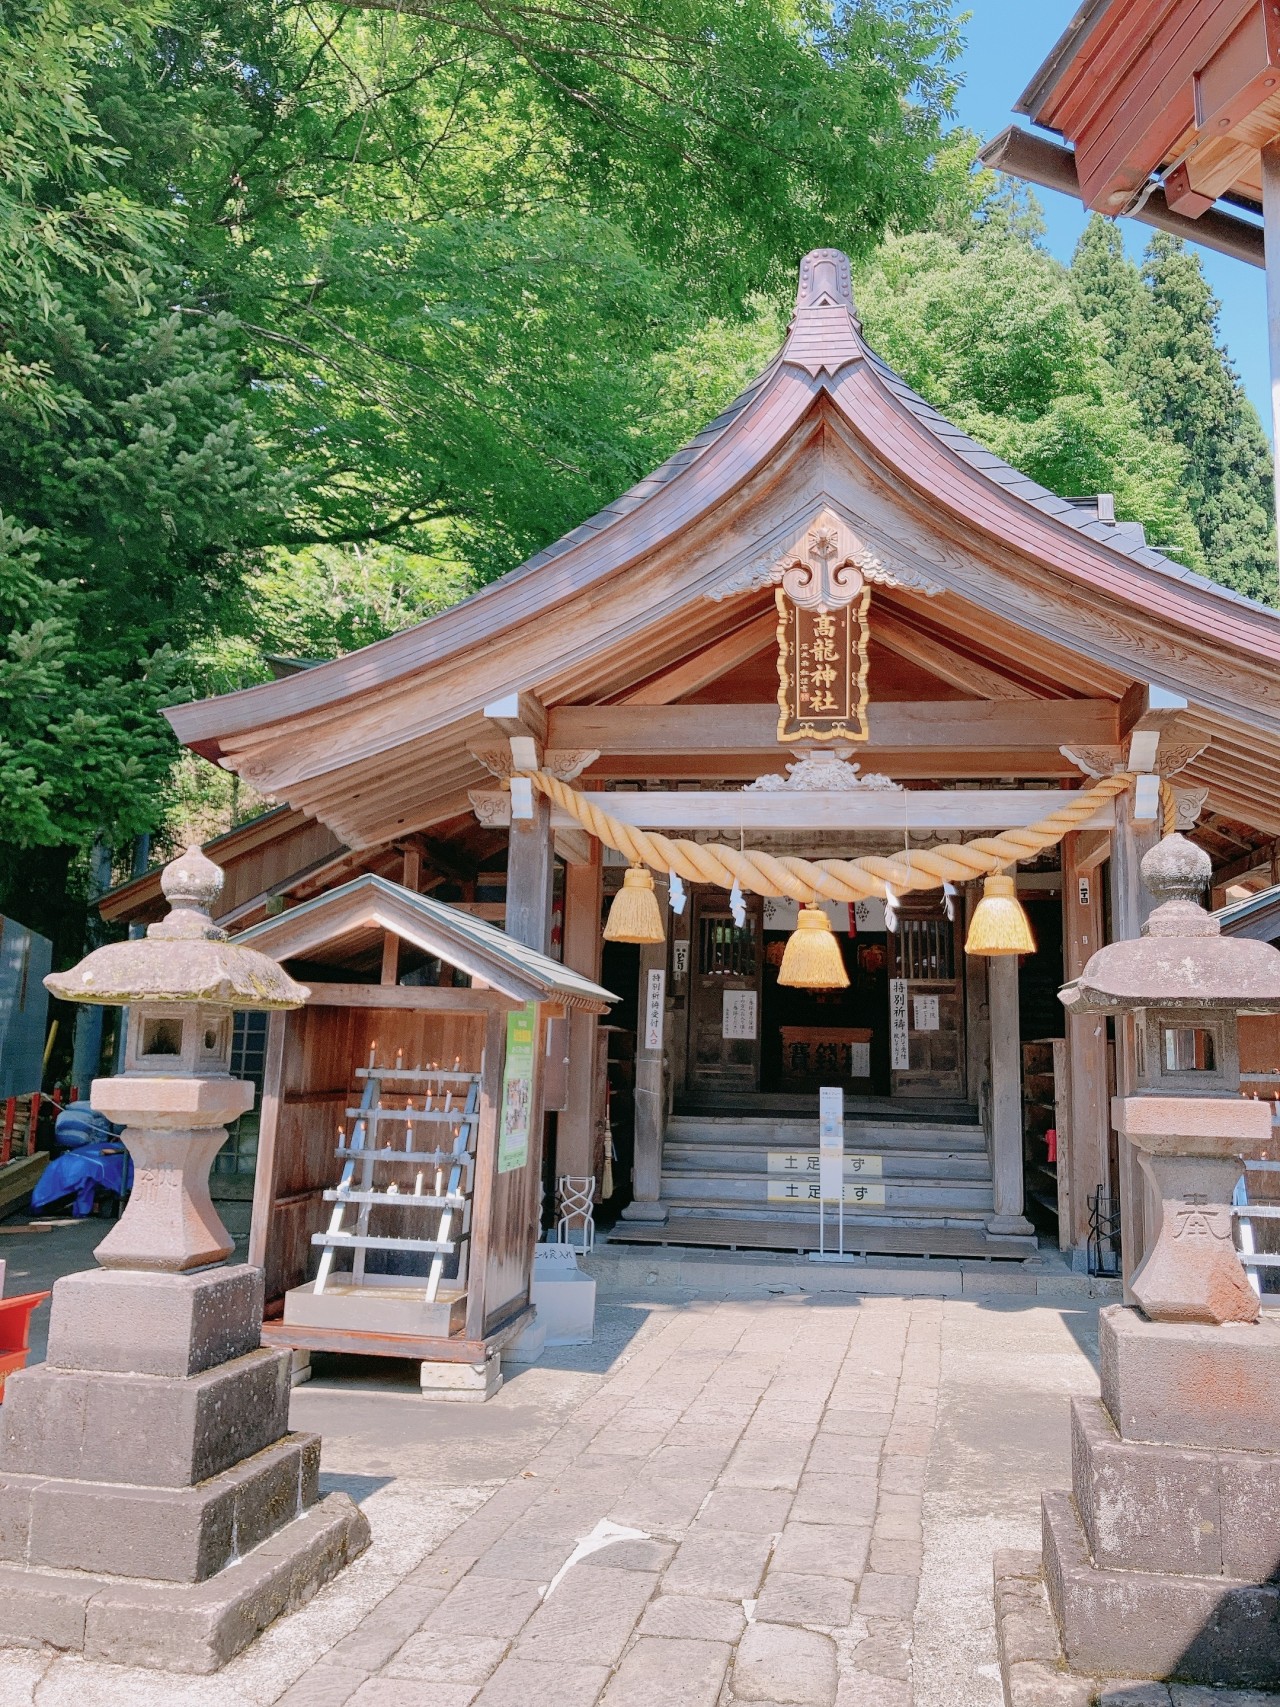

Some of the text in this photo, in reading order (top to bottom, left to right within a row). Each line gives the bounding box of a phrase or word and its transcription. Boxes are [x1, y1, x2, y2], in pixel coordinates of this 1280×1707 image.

[784, 1155, 865, 1172] 土足ず
[785, 1184, 869, 1201] 土足ず
